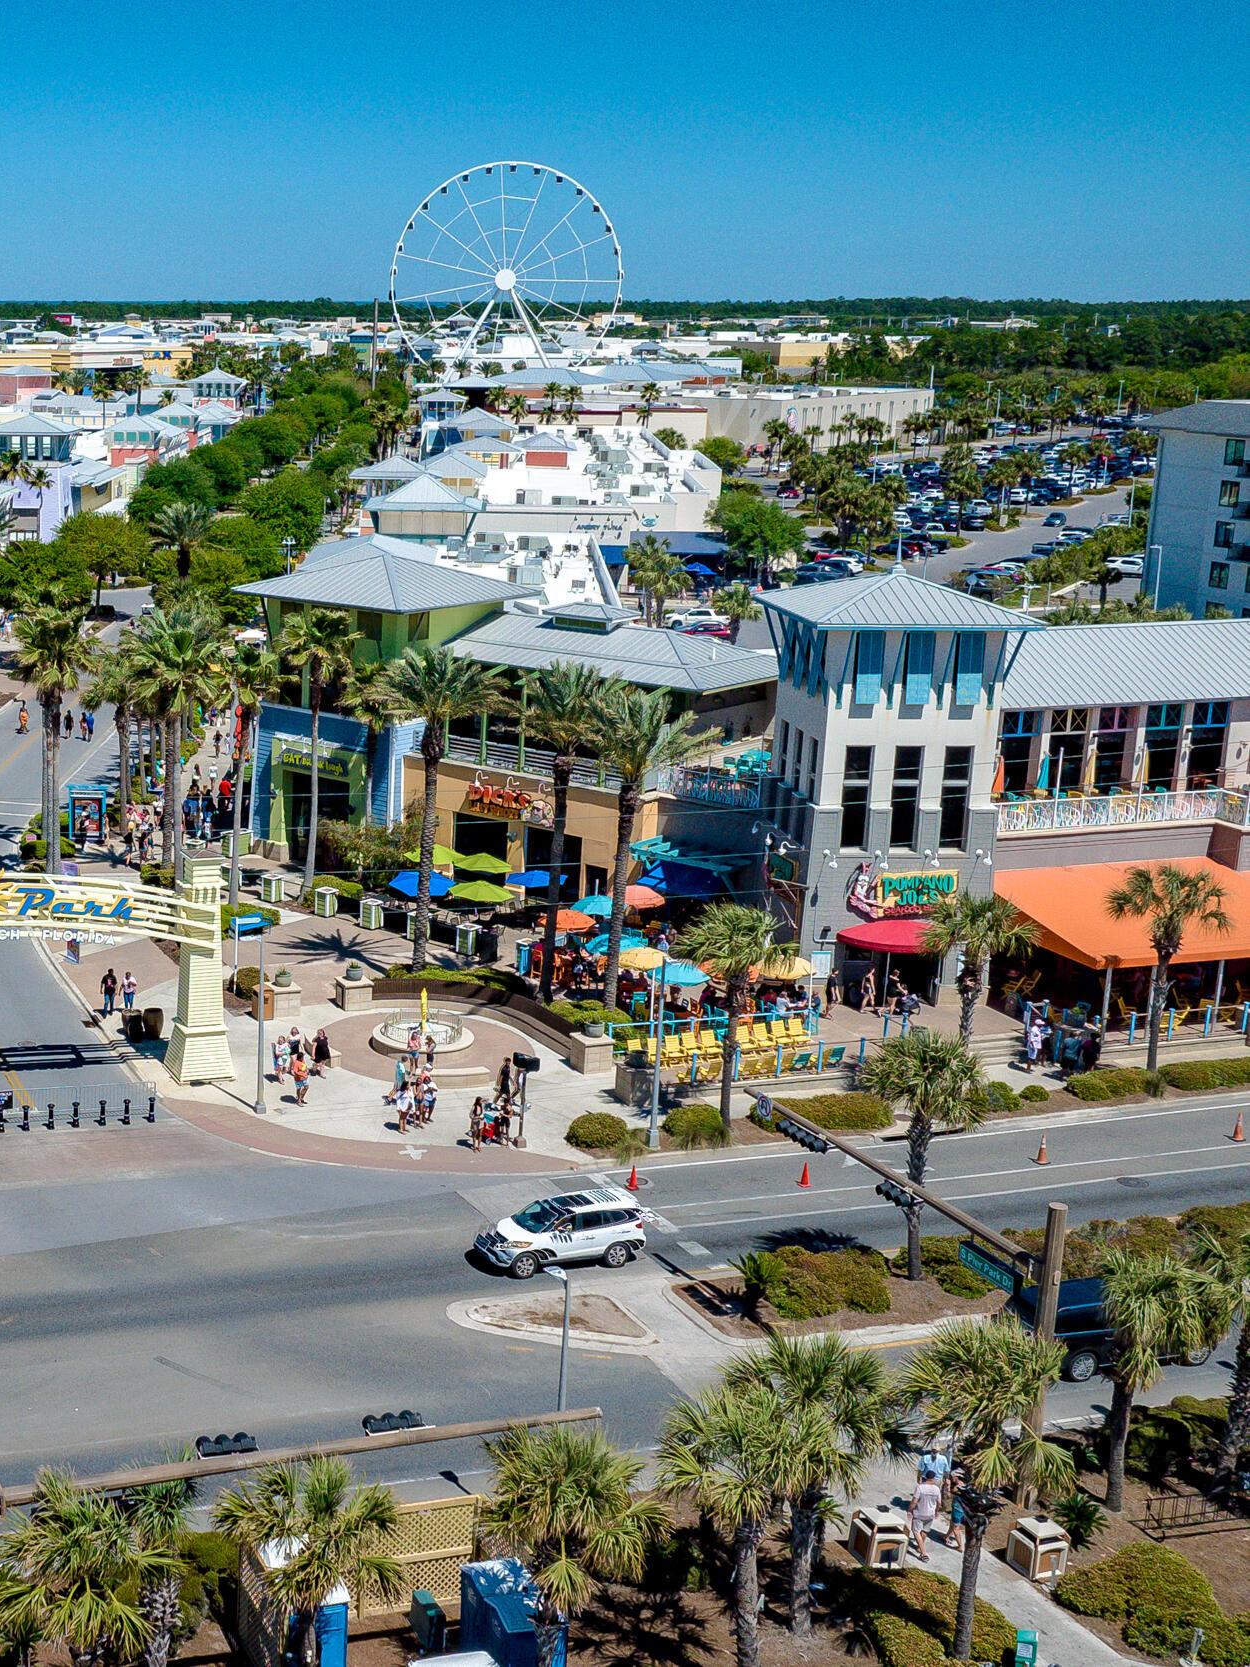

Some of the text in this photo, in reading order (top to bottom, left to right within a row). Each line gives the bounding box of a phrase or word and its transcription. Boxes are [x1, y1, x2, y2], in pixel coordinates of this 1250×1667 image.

[283, 753, 301, 765] EAT
[469, 783, 532, 810] DICK'S
[882, 874, 955, 899] POMPANO
[11, 884, 148, 922] Park
[41, 929, 117, 947] FLORIDA
[967, 1253, 983, 1269] Pier
[983, 1262, 1001, 1281] Park
